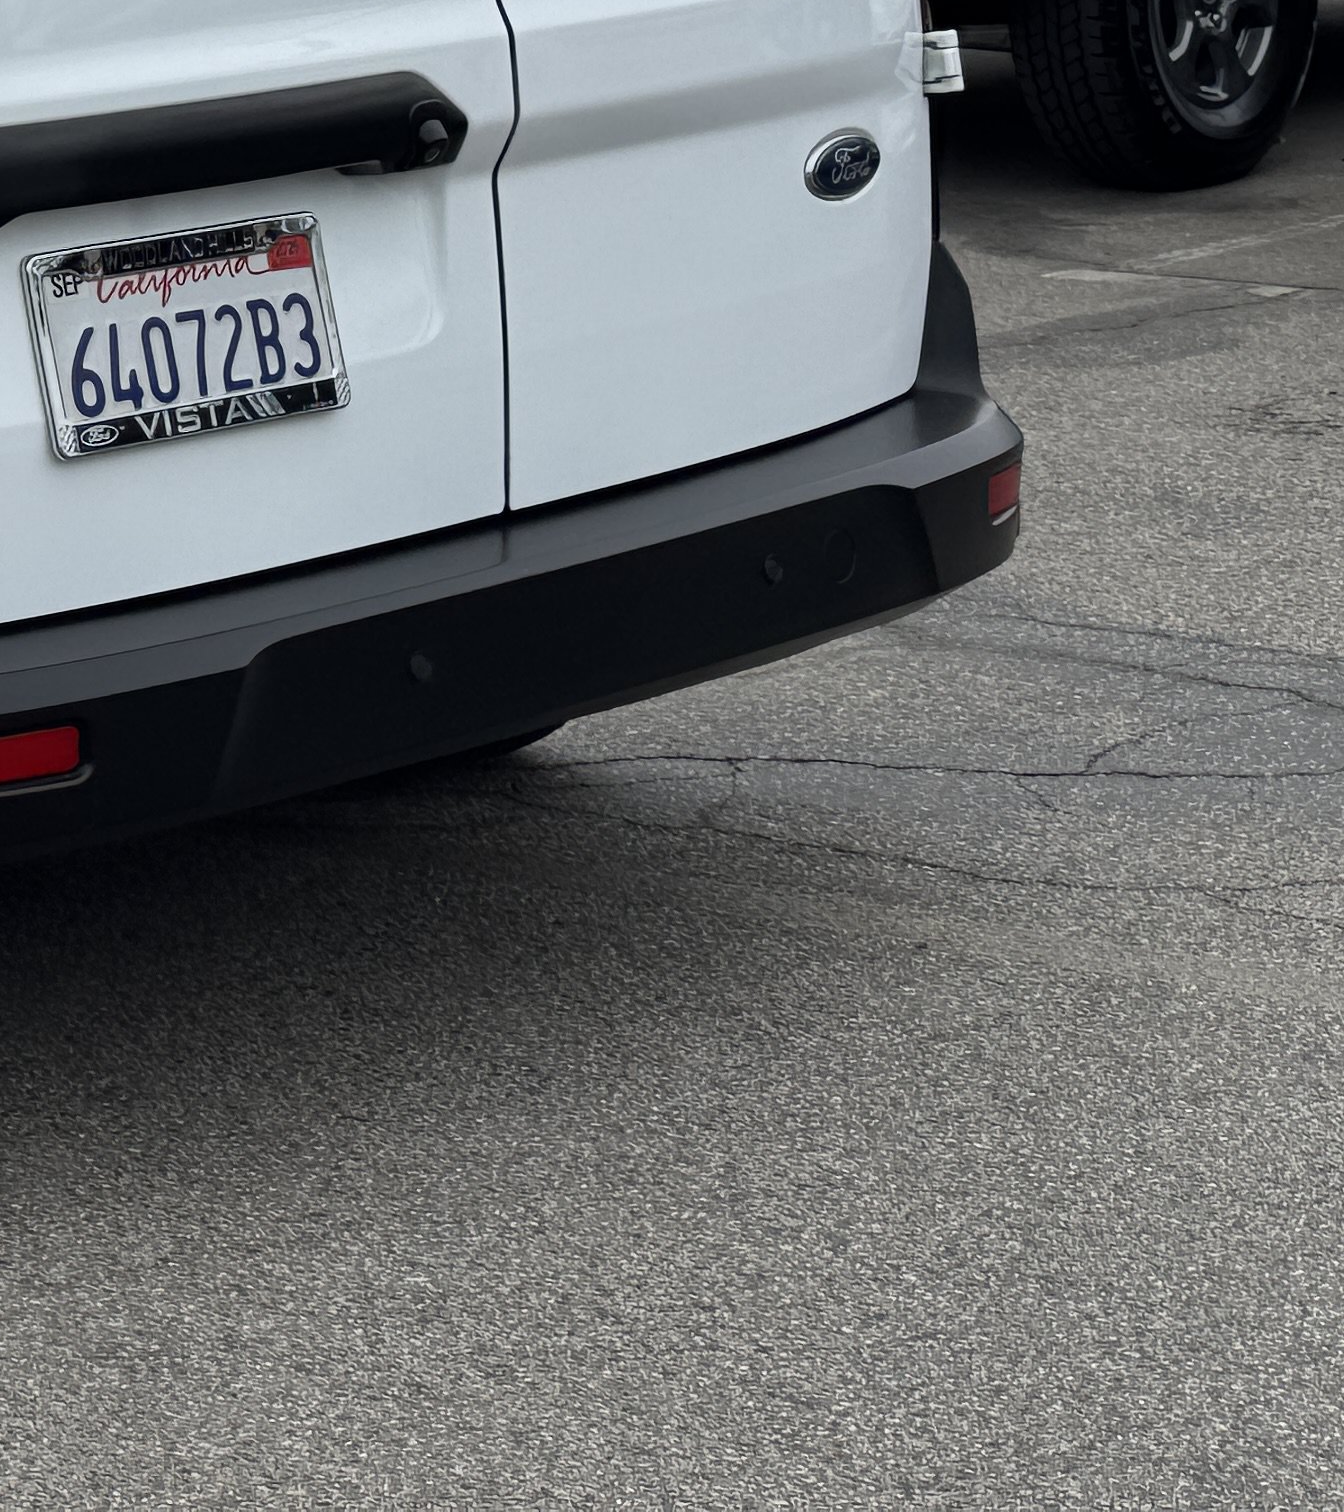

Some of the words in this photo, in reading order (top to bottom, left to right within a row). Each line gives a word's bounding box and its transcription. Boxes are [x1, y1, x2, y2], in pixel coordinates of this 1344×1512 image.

[50, 273, 82, 299] SEP
[96, 255, 269, 308] California
[71, 292, 322, 418] 64072B3
[135, 395, 249, 440] VISTA
